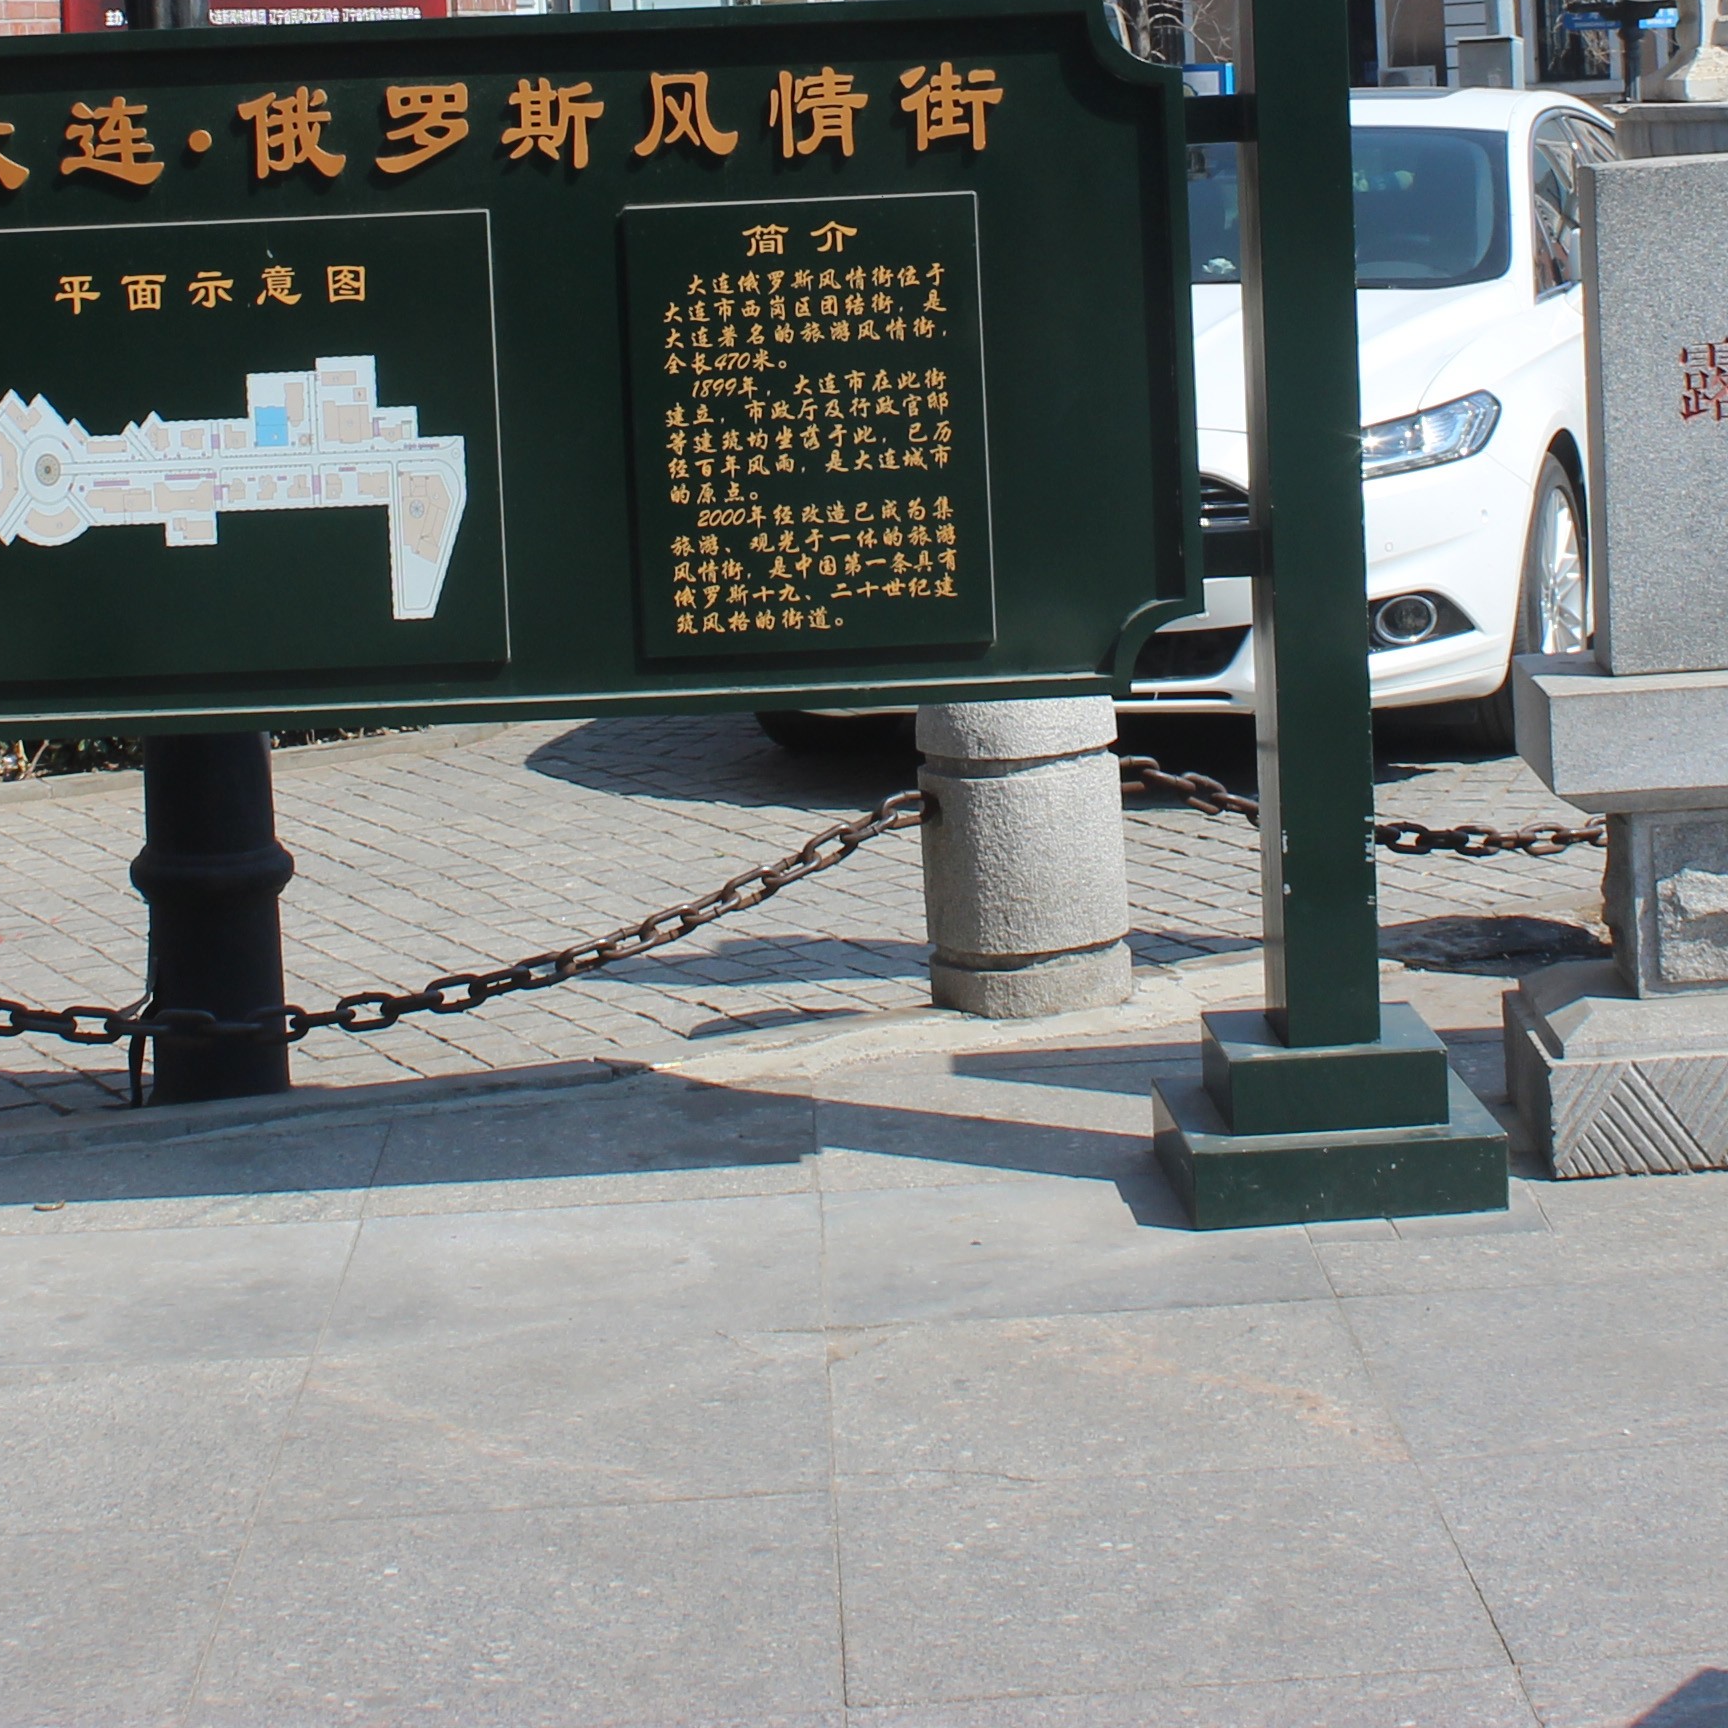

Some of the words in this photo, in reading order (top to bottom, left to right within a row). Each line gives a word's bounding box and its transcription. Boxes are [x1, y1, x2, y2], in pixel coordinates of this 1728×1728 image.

[742, 221, 858, 257] 简介
[55, 264, 370, 317] 平面示意图
[687, 262, 945, 295] 大连俄罗斯风情街位于
[664, 289, 947, 323] 大连市西岗区团结街，是
[664, 319, 947, 349] 大连著名的旅游风情街，
[664, 351, 787, 374] 全长470米。
[668, 444, 951, 479] 经百年风雨，是大连城市
[670, 481, 758, 505] 的原点。
[697, 496, 954, 528] 2000年经改造已成为集
[671, 524, 956, 557] 旅游、观光于一体的旅游
[673, 577, 958, 608] 俄罗斯十九、二十世纪建
[676, 605, 844, 635] 筑风格的街道。
